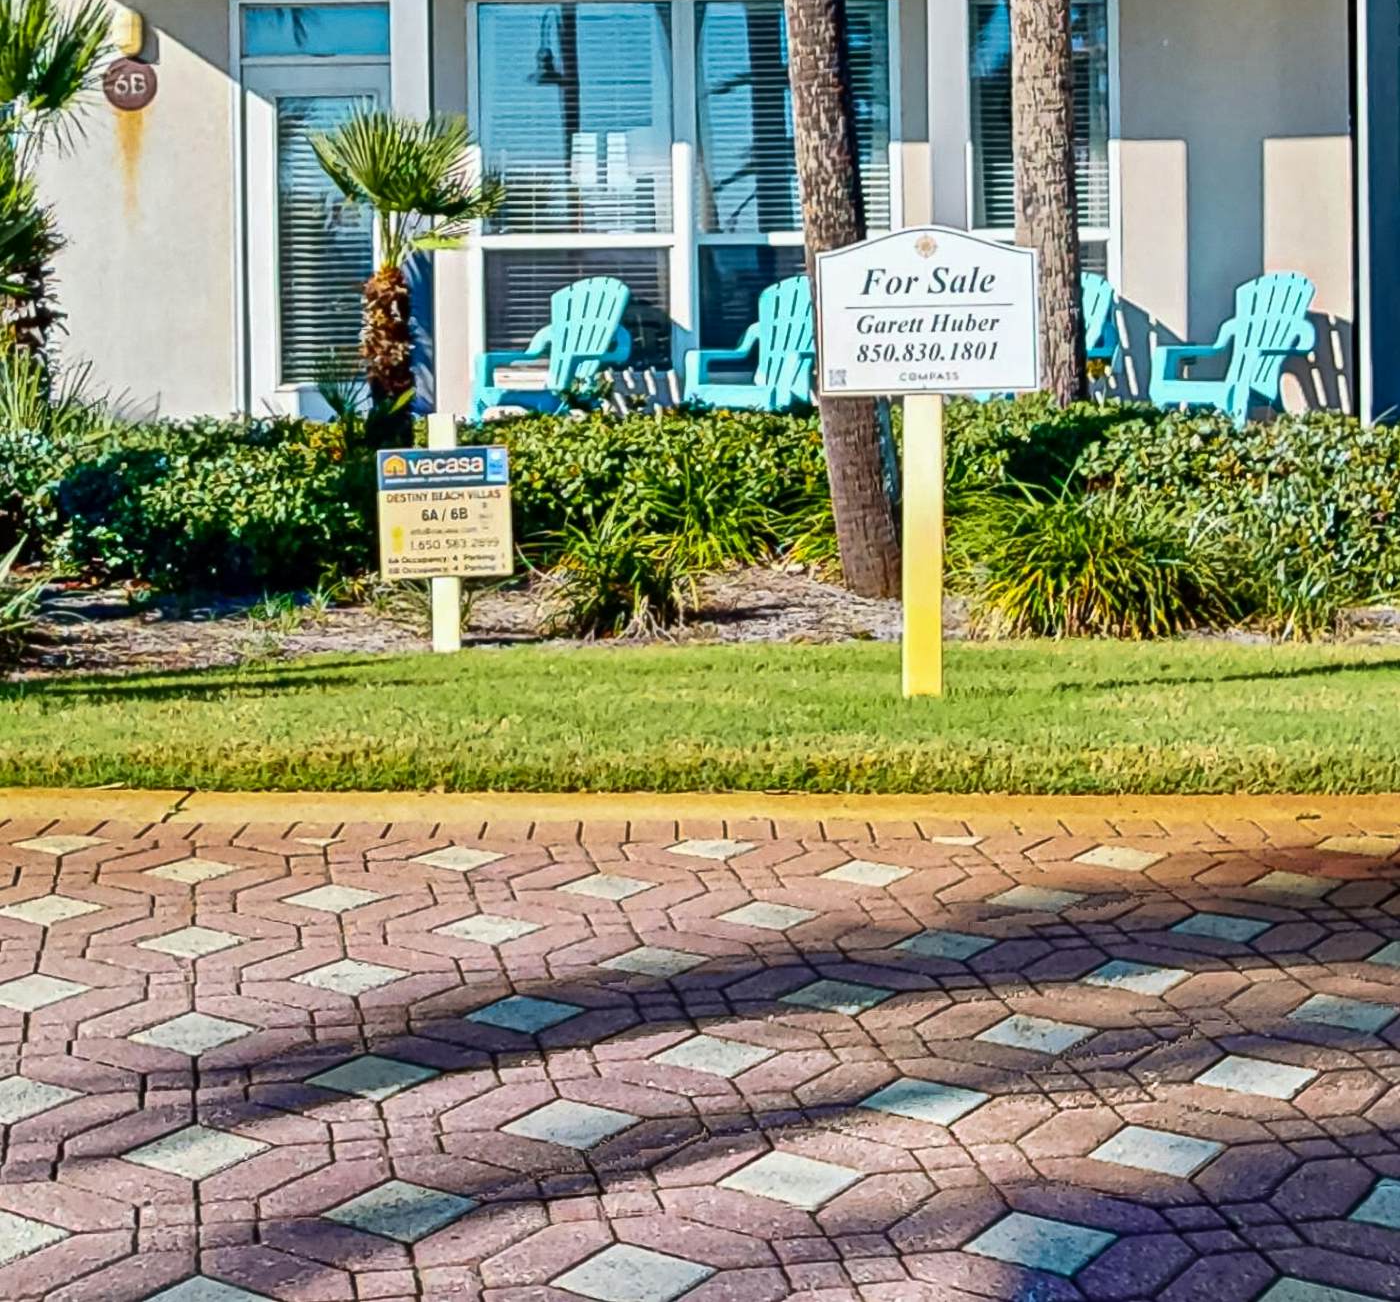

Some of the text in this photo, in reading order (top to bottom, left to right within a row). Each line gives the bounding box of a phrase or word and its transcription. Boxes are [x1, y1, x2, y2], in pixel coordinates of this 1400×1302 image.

[114, 73, 147, 94] 6B
[860, 266, 996, 296] For Sale
[856, 313, 1000, 335] Garett Huber
[856, 340, 999, 363] 850.830.1801
[899, 371, 960, 382] COMPASS
[408, 456, 484, 475] vacasa
[386, 489, 501, 503] DESTINY BEACH VILLAS
[421, 508, 438, 522] 6A
[450, 507, 469, 521] 6B
